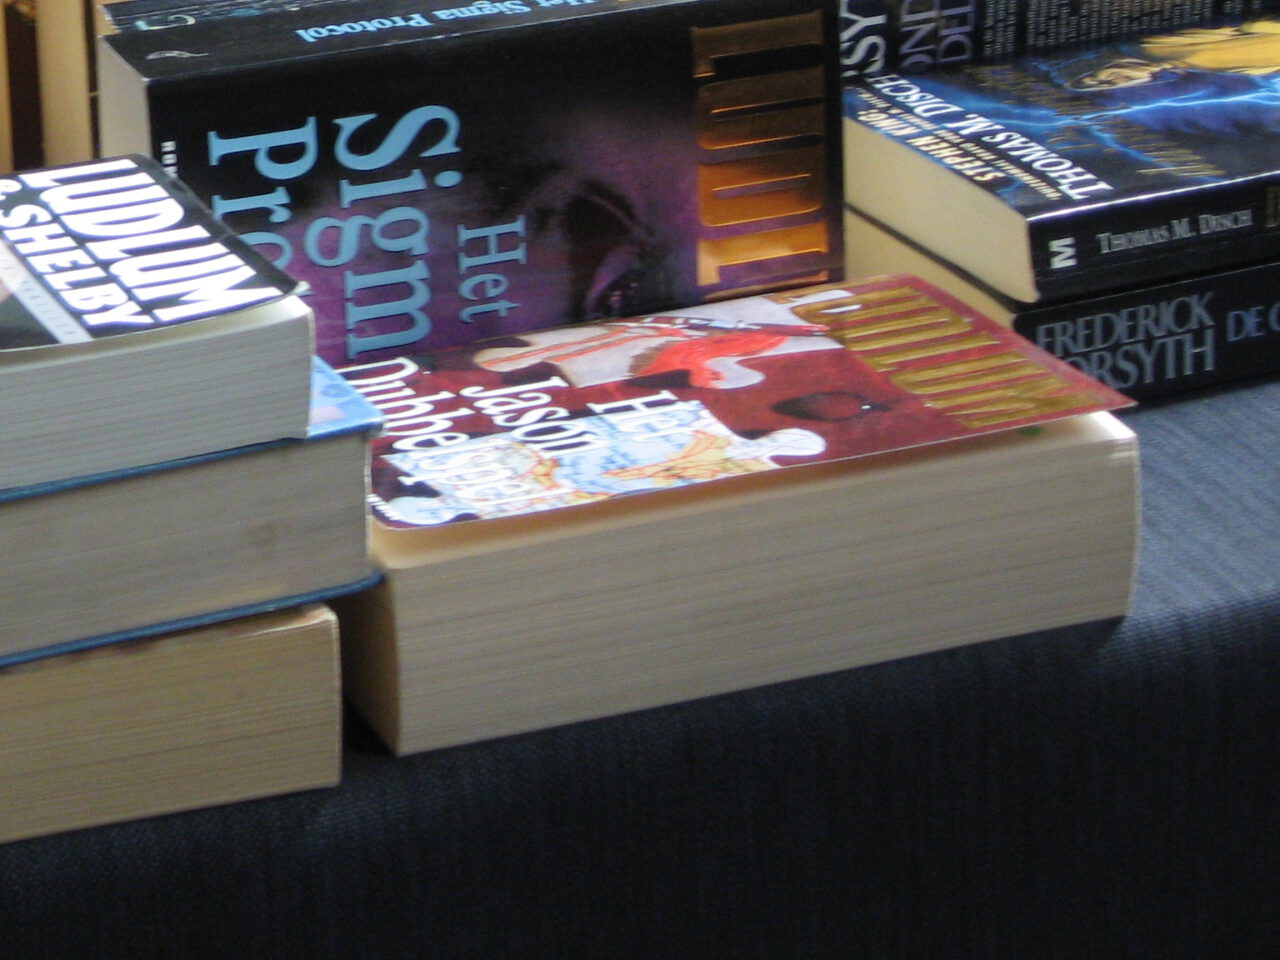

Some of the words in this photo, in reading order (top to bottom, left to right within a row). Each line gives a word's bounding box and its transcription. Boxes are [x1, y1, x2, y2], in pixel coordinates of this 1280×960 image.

[293, 12, 433, 43] Protocol
[861, 73, 965, 118] DISCH
[206, 116, 318, 270] Pro
[905, 136, 1007, 182] STEPHEN
[981, 131, 1115, 200] THOMAS
[15, 158, 286, 323] LUDLUM
[305, 103, 463, 361] Sigm
[458, 214, 528, 323] Het
[1034, 290, 1216, 353] FREDERICK
[1226, 305, 1266, 343] DE
[769, 285, 1106, 429] LUDLUM
[1064, 327, 1216, 390] ORSYTH
[342, 355, 542, 506] Dubbelspel
[458, 375, 609, 458] Jason
[586, 389, 692, 440] Het
